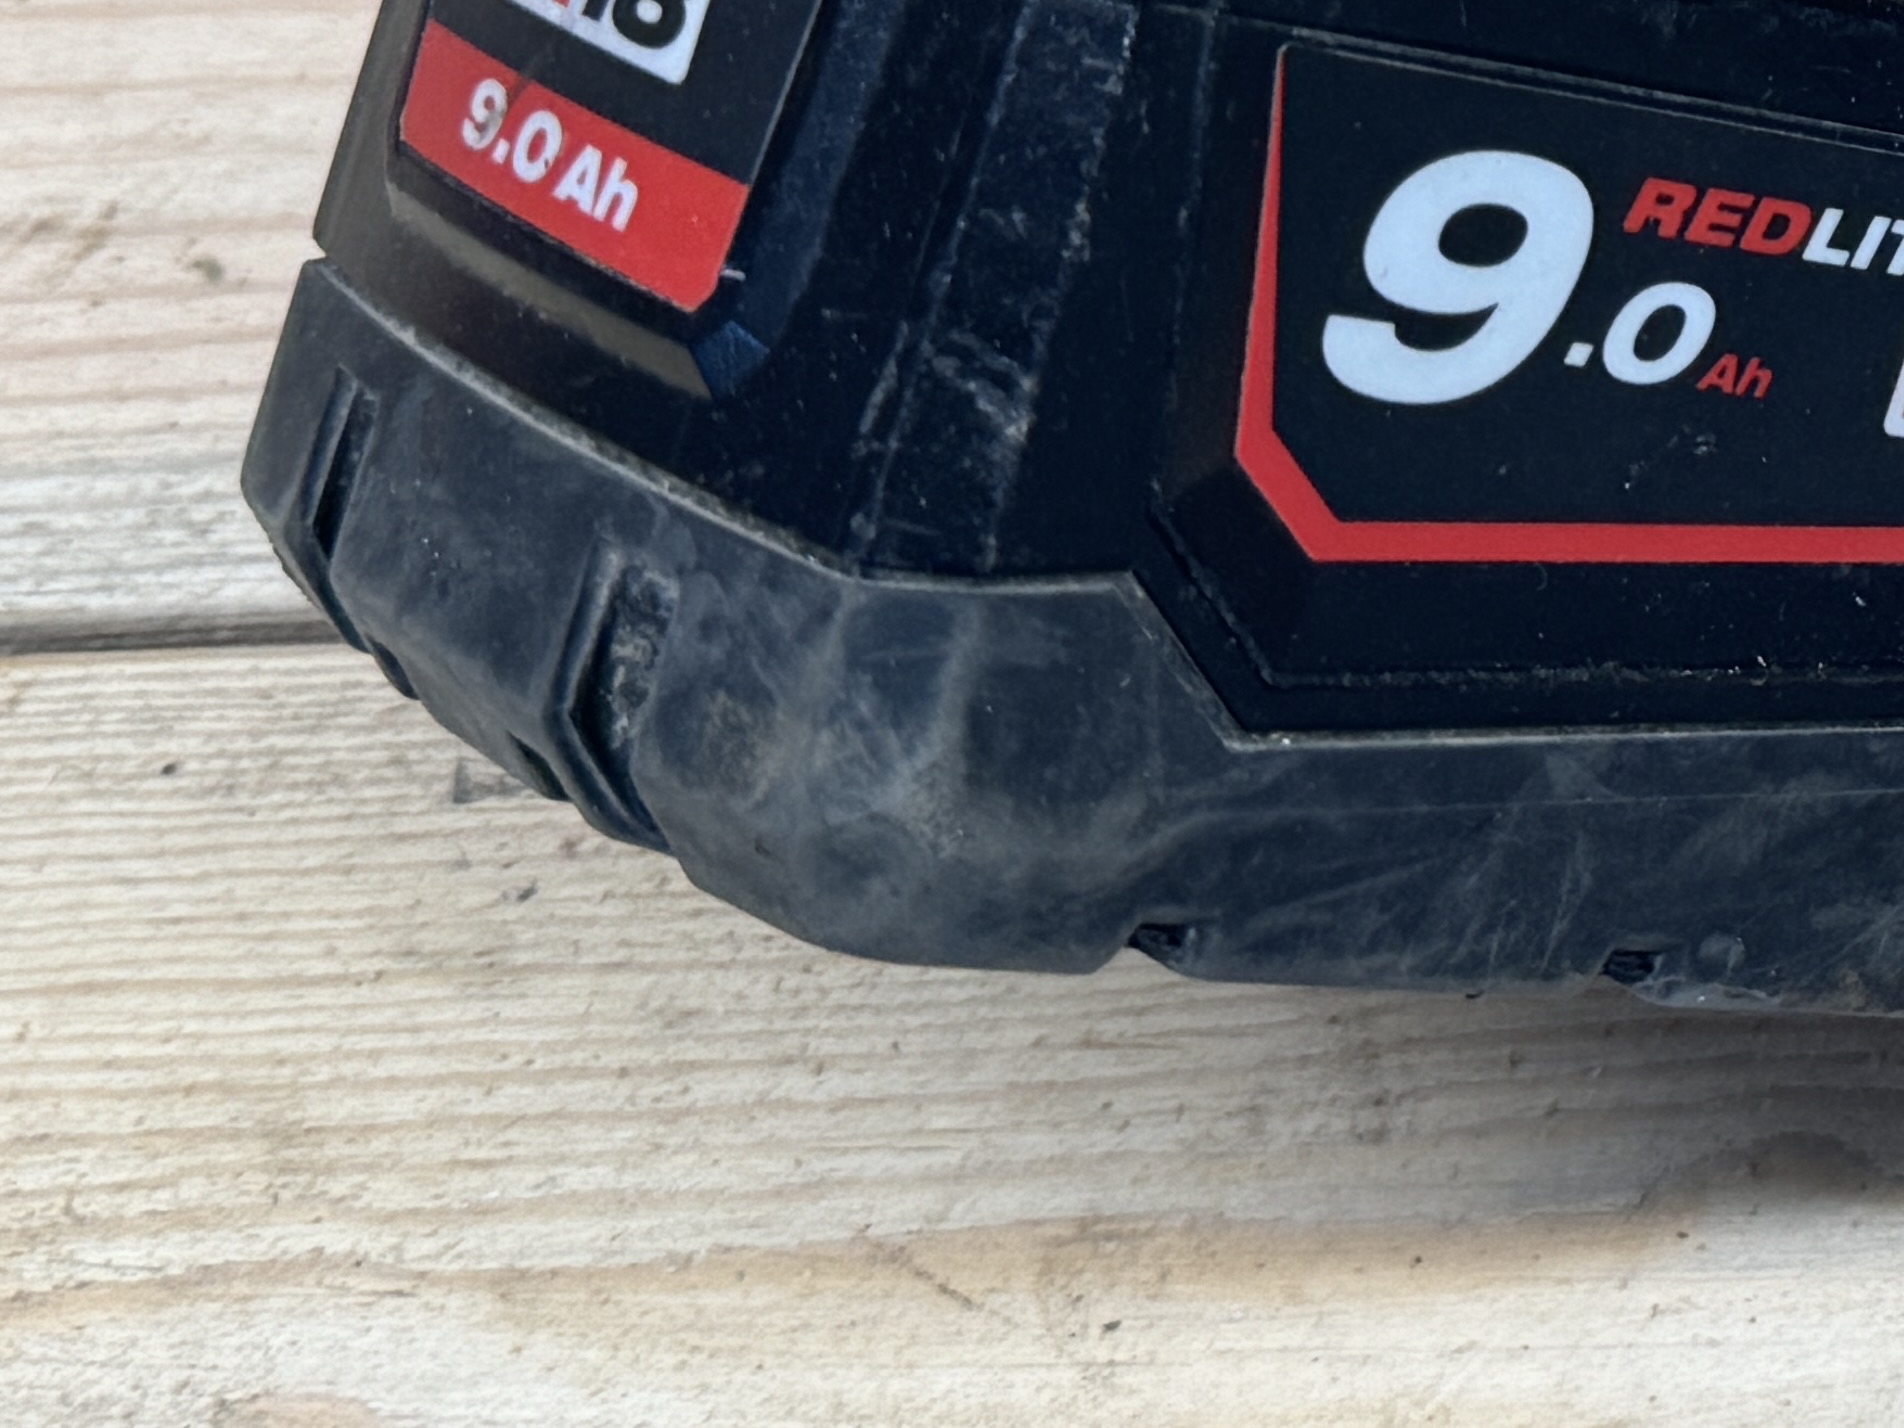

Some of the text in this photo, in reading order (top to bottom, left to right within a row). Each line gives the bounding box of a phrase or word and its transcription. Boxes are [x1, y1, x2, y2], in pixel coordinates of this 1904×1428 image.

[461, 78, 640, 232] 9.0 Ah
[1321, 149, 1773, 406] 9.0 Ah
